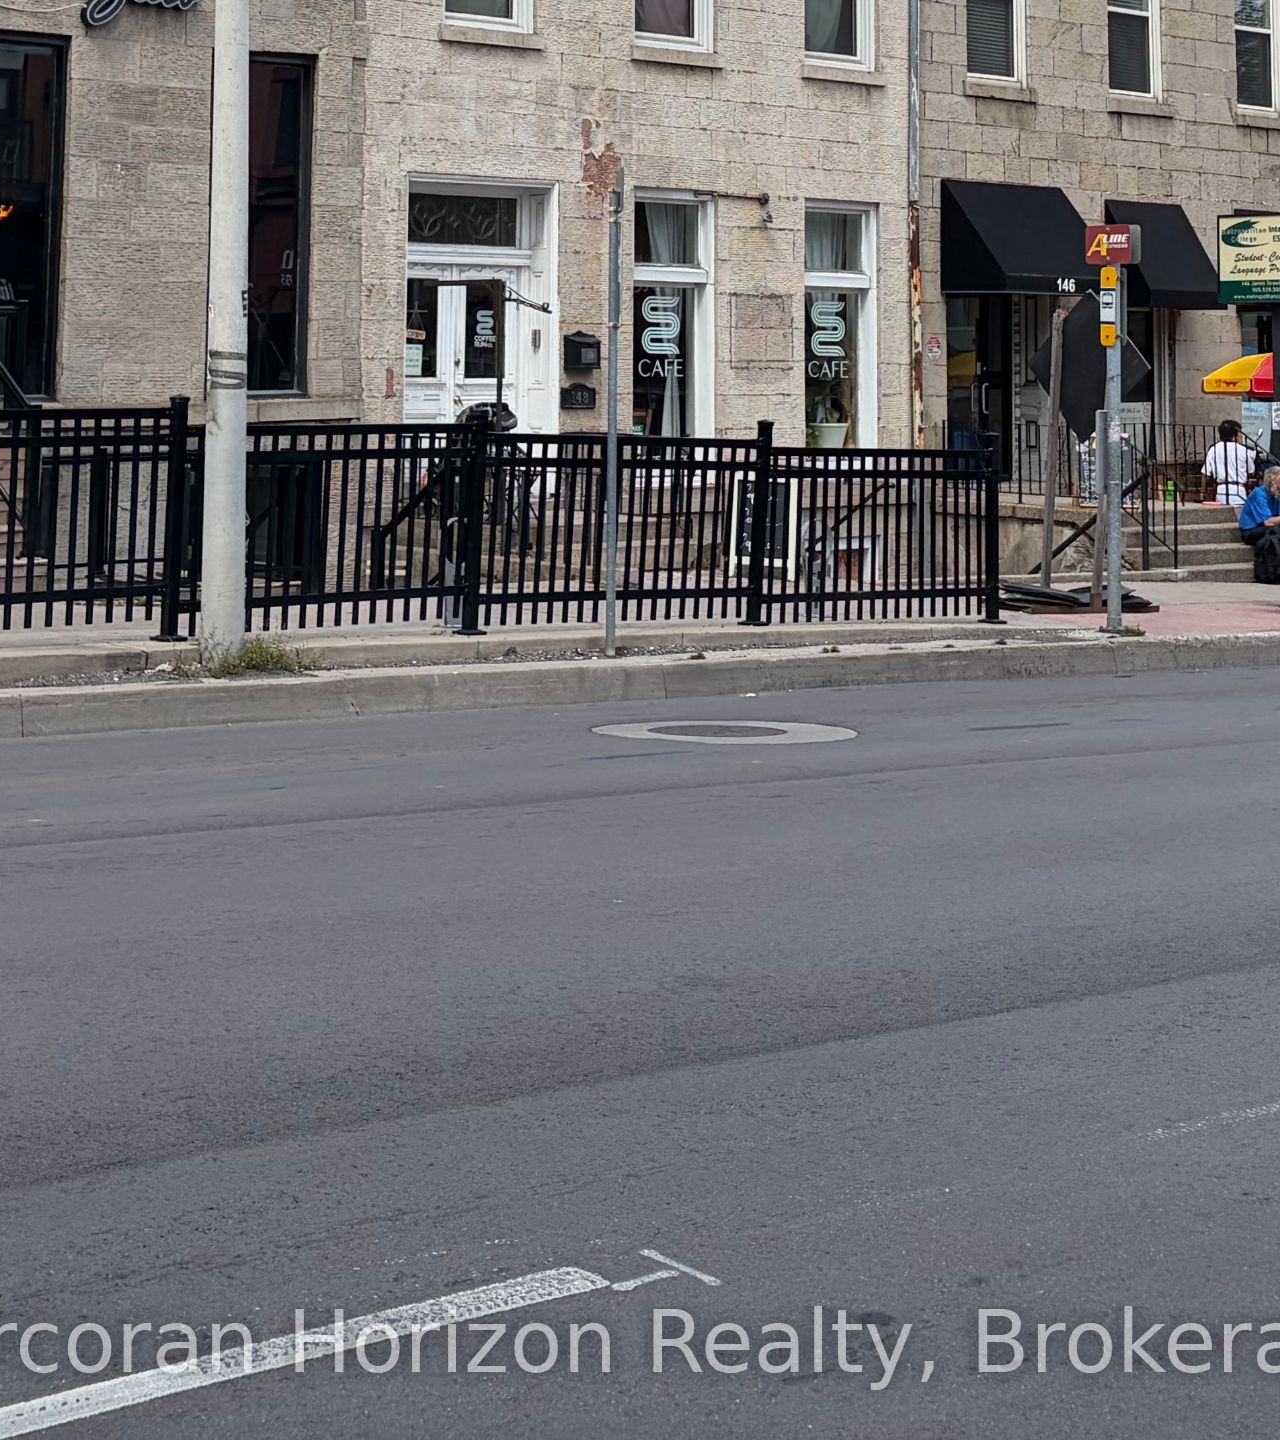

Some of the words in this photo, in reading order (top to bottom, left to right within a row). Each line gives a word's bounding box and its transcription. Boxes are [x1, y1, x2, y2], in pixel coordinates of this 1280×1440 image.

[1086, 233, 1108, 256] A
[1229, 264, 1266, 276] Language
[1056, 277, 1076, 293] 146
[638, 359, 684, 378] CAFE
[808, 360, 849, 379] CAFE
[571, 391, 589, 404] 148
